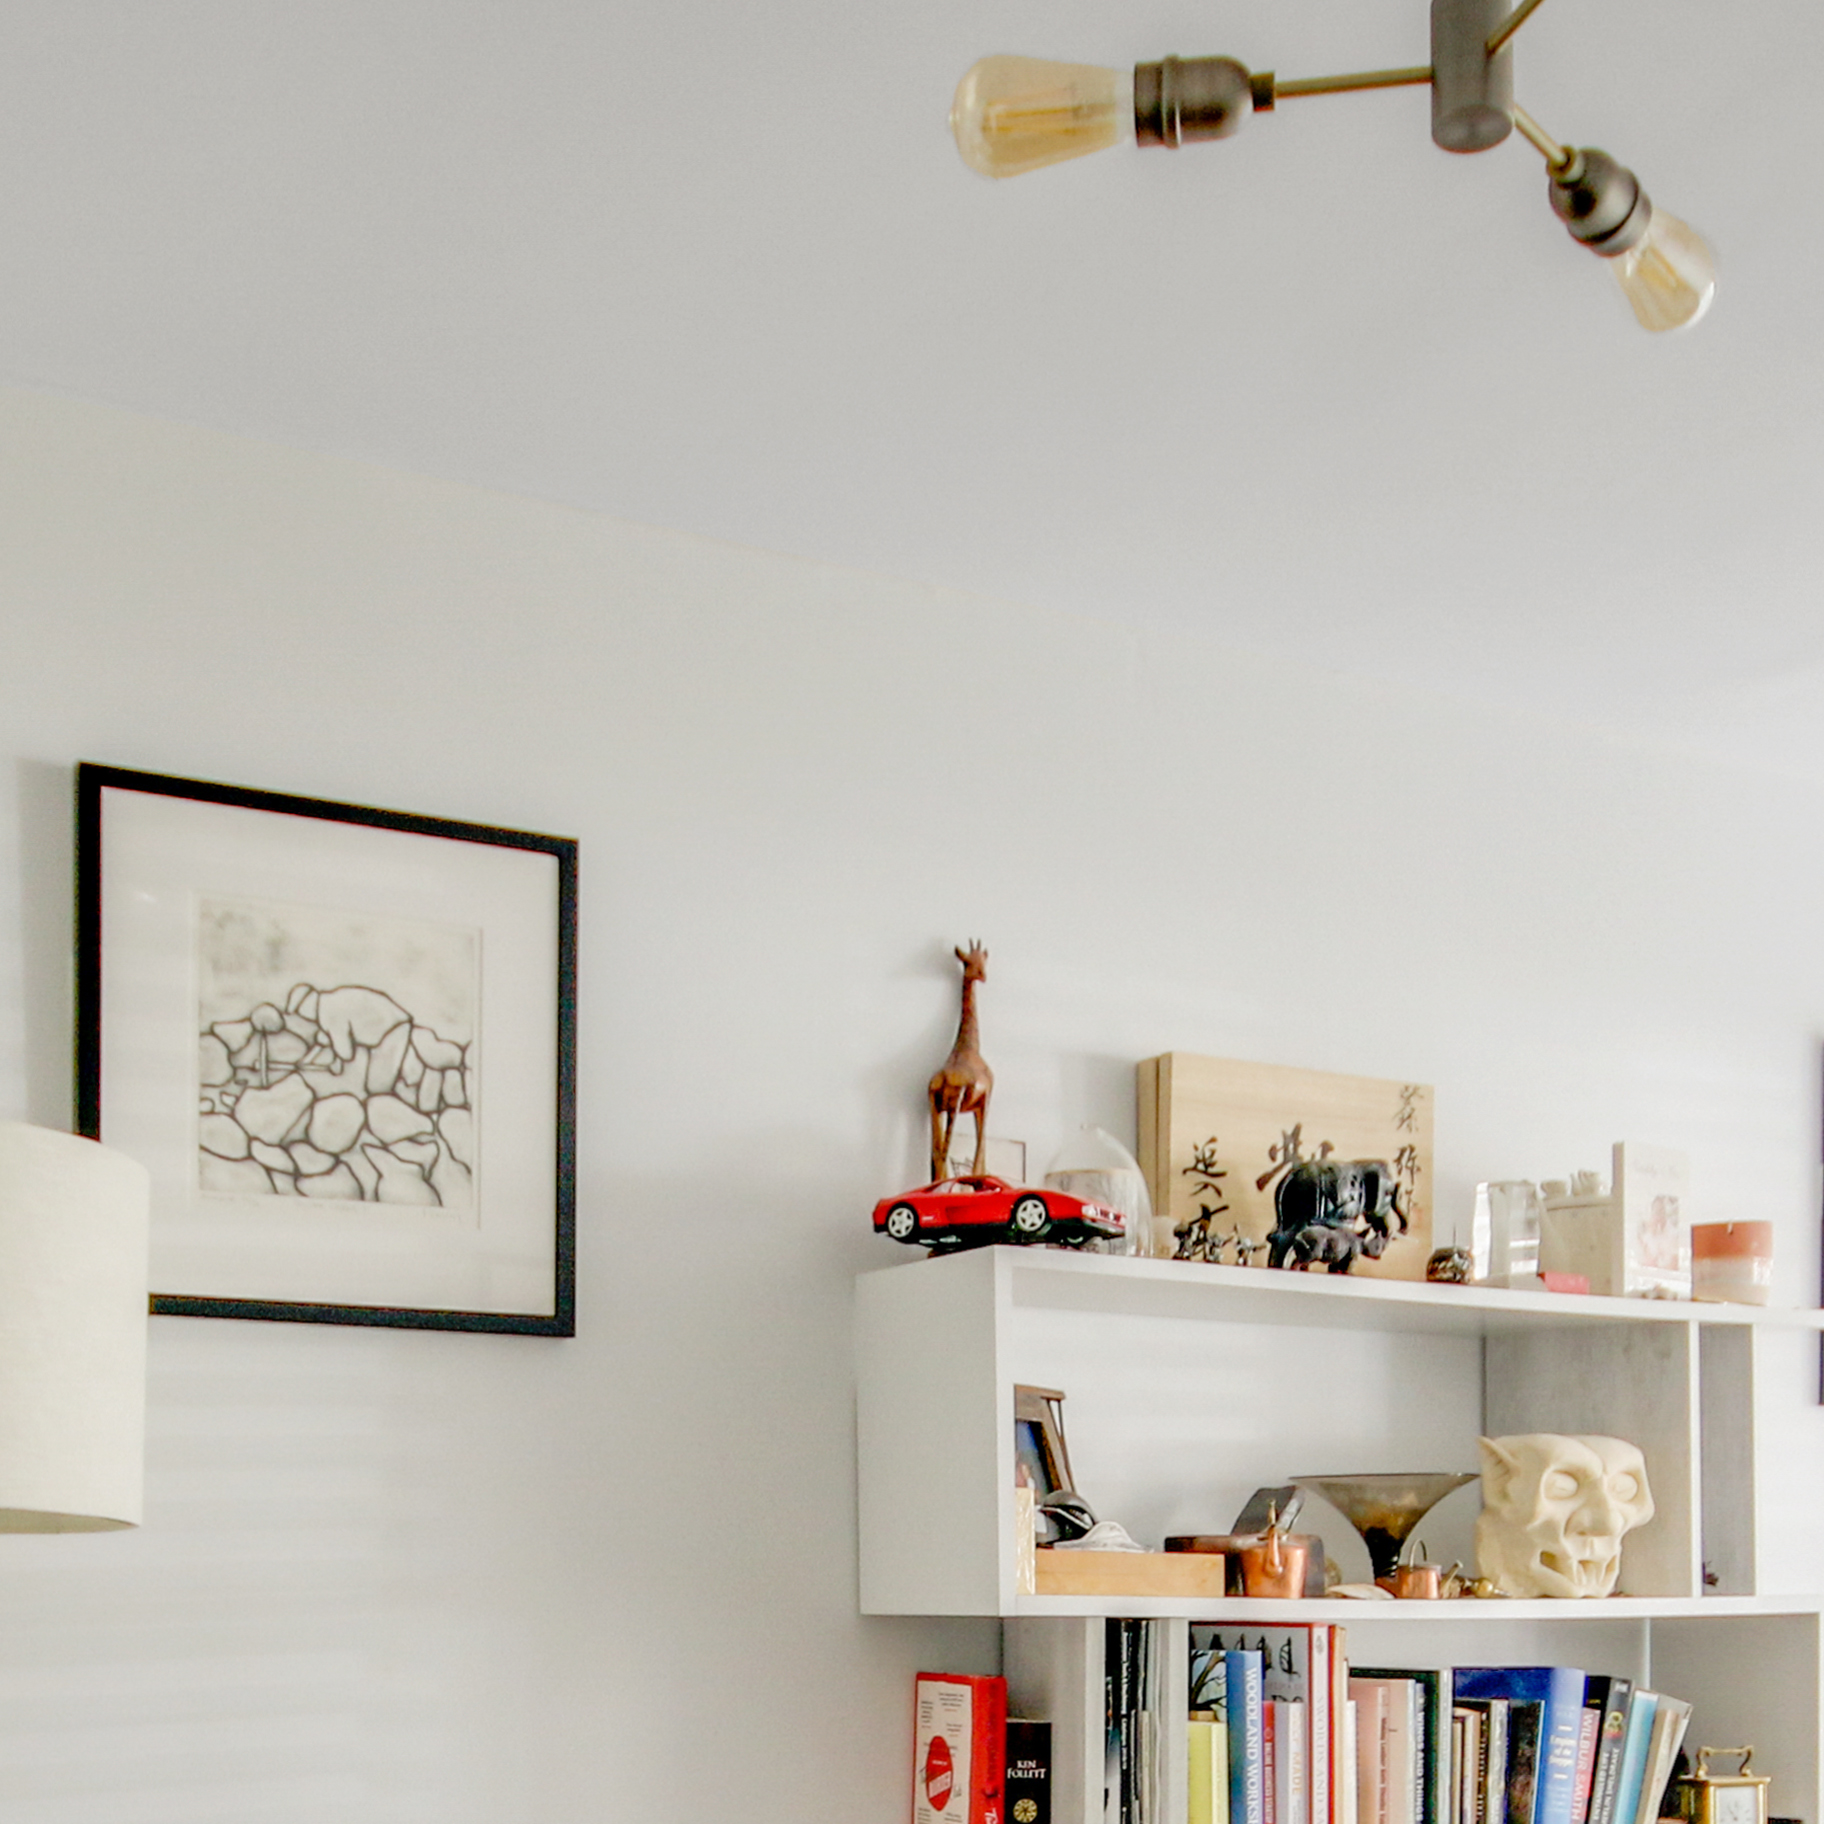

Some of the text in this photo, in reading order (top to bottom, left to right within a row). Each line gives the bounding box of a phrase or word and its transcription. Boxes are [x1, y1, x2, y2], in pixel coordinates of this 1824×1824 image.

[1245, 1667, 1259, 1761] WOODLAND
[1416, 1711, 1425, 1749] WINGS
[1007, 1768, 1046, 1779] FOLLETT
[1017, 1760, 1036, 1768] KEN
[1416, 1752, 1425, 1777] AND
[1571, 1712, 1594, 1820] WILBUR SMITH
[1416, 1779, 1425, 1821] THINGS
[1593, 1772, 1606, 1820] ENTANGLED
